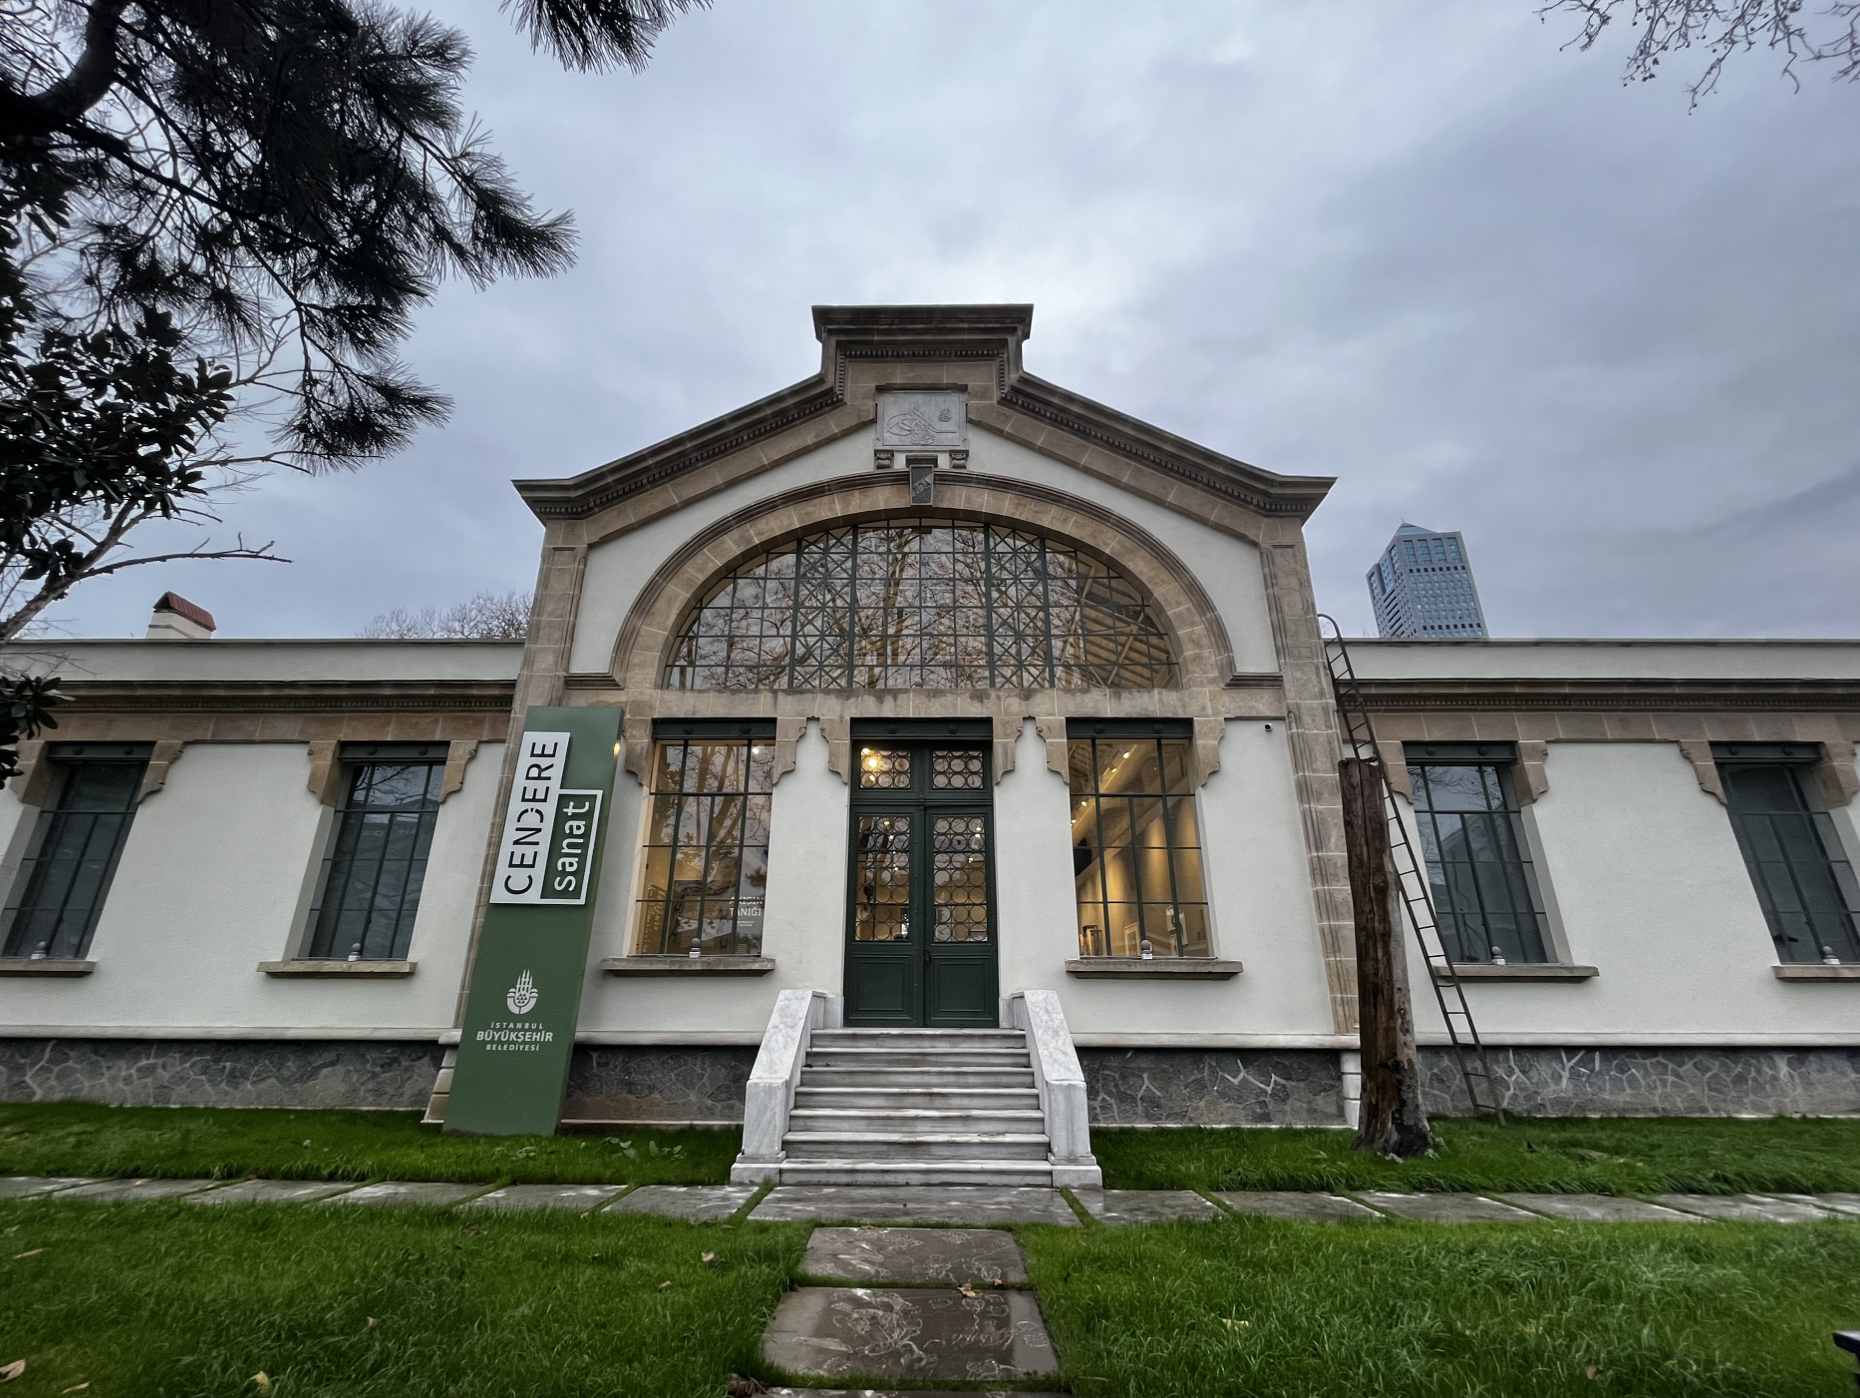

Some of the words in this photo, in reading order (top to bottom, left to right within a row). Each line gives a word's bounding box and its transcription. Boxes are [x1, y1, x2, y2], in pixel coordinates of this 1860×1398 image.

[504, 742, 559, 895] CENDERE
[554, 801, 590, 892] sanat
[490, 1021, 543, 1030] İSTANBUL
[476, 1029, 554, 1042] BÜYÜKŞEHİR
[485, 1043, 540, 1051] BELEDİYESİ
